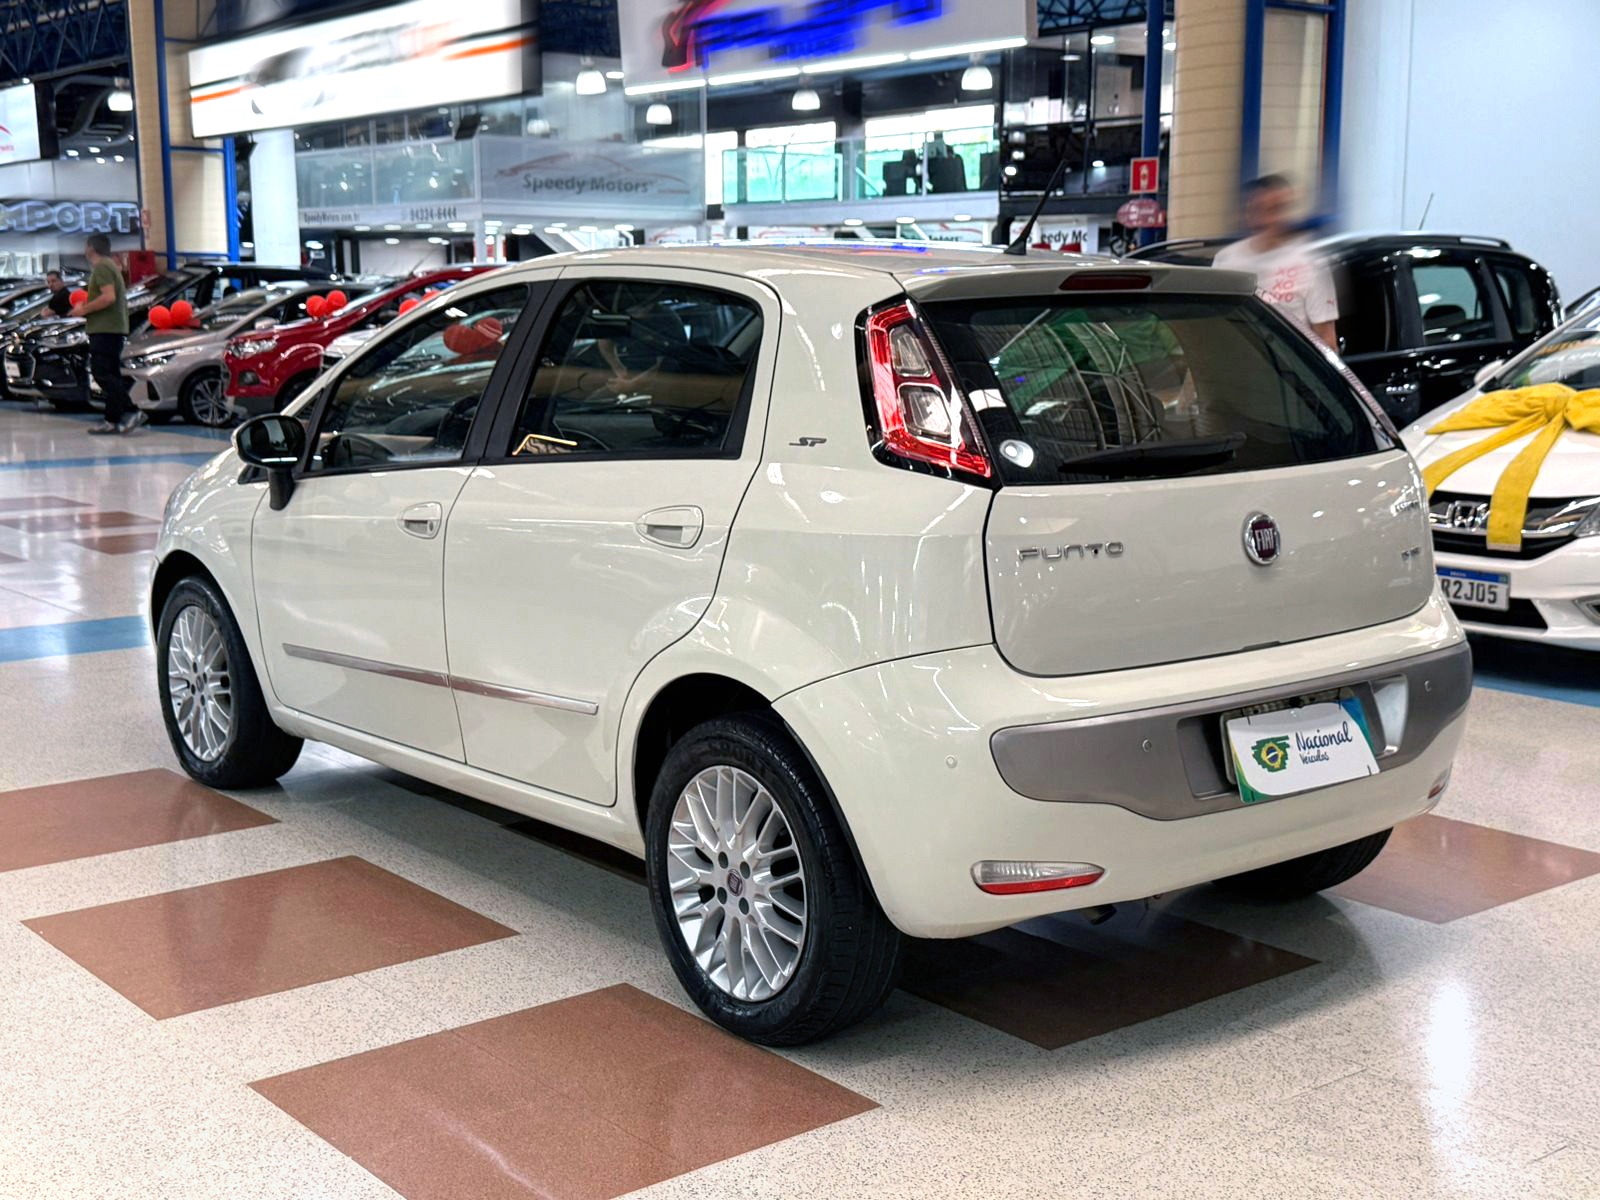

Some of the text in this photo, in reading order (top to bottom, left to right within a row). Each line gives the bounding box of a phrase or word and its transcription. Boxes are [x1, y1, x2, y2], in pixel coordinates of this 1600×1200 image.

[523, 174, 649, 194] Speedy Motors
[0, 200, 139, 232] MPORT
[1255, 527, 1275, 551] FIAT
[1441, 578, 1498, 604] R2J05
[1295, 720, 1353, 752] Nacional
